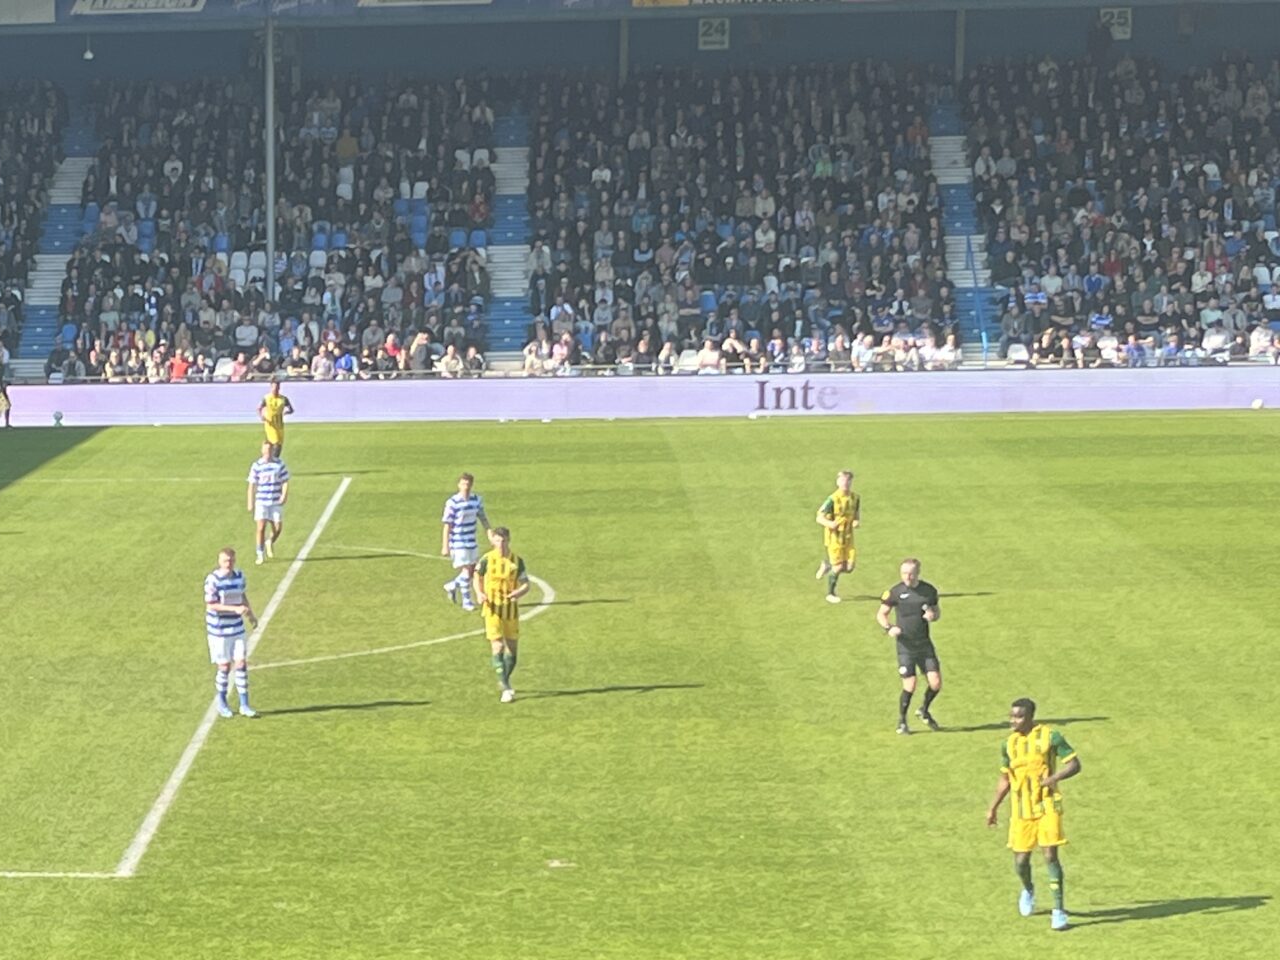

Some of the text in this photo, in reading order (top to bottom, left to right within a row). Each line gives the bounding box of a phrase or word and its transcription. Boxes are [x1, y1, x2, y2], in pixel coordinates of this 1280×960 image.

[1102, 11, 1129, 26] 25
[701, 20, 726, 37] 24
[754, 379, 840, 410] Inte
